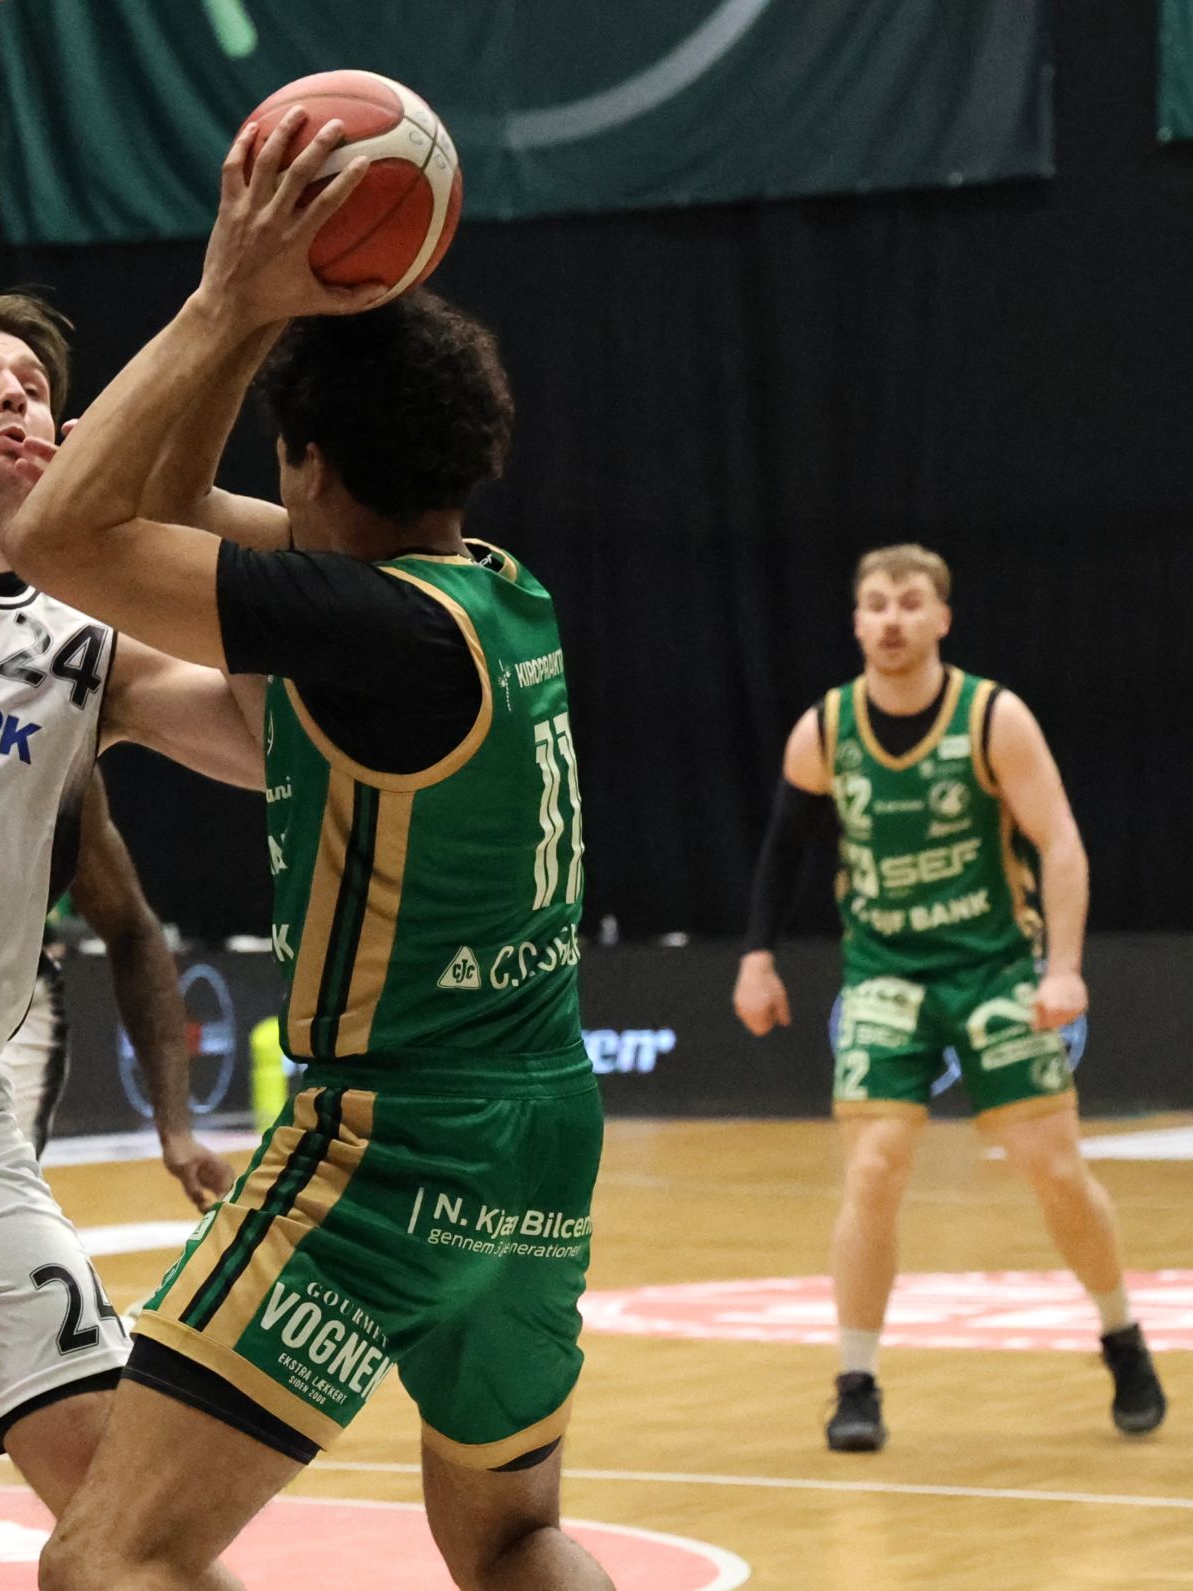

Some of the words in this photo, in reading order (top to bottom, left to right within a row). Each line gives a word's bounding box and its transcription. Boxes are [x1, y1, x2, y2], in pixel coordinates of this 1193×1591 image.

[532, 712, 586, 911] 11
[879, 837, 983, 889] SEF
[433, 1192, 468, 1227] N.
[427, 1227, 495, 1256] gennem
[306, 1281, 390, 1348] GOURMET
[277, 1352, 313, 1382] EKSTRA
[312, 1375, 348, 1406] LÆKKERT
[288, 1375, 310, 1396] SIDEN
